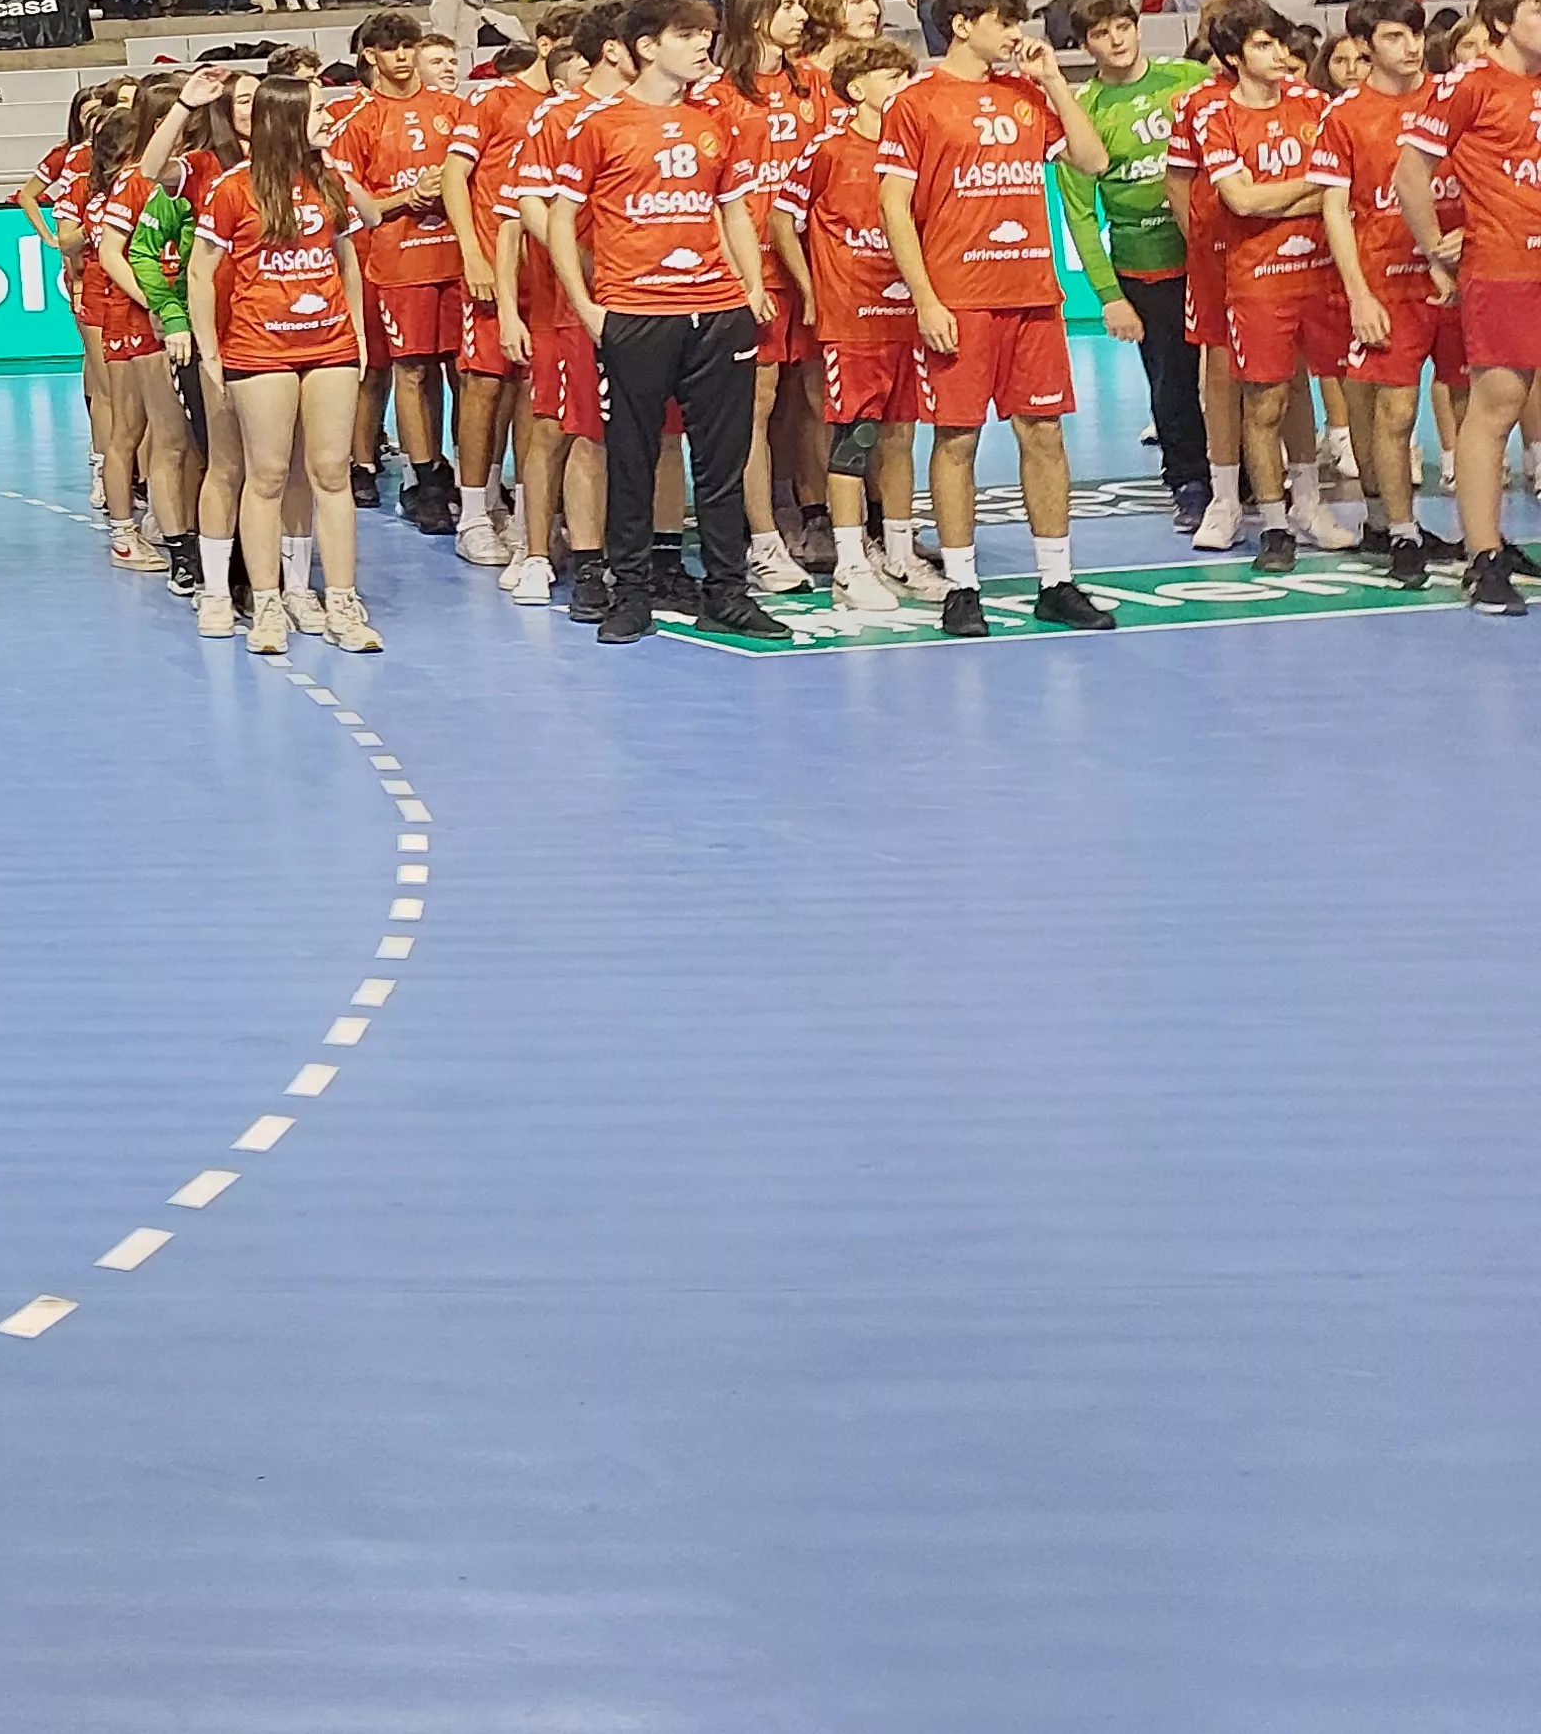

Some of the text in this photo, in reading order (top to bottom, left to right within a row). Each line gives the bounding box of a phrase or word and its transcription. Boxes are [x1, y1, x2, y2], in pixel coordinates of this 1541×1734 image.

[408, 129, 426, 151] 2
[767, 113, 797, 142] 22
[972, 116, 1017, 145] 20
[1132, 108, 1172, 145] 16
[653, 143, 698, 179] 18
[1258, 137, 1302, 176] 40
[954, 160, 1045, 189] LASAOSA
